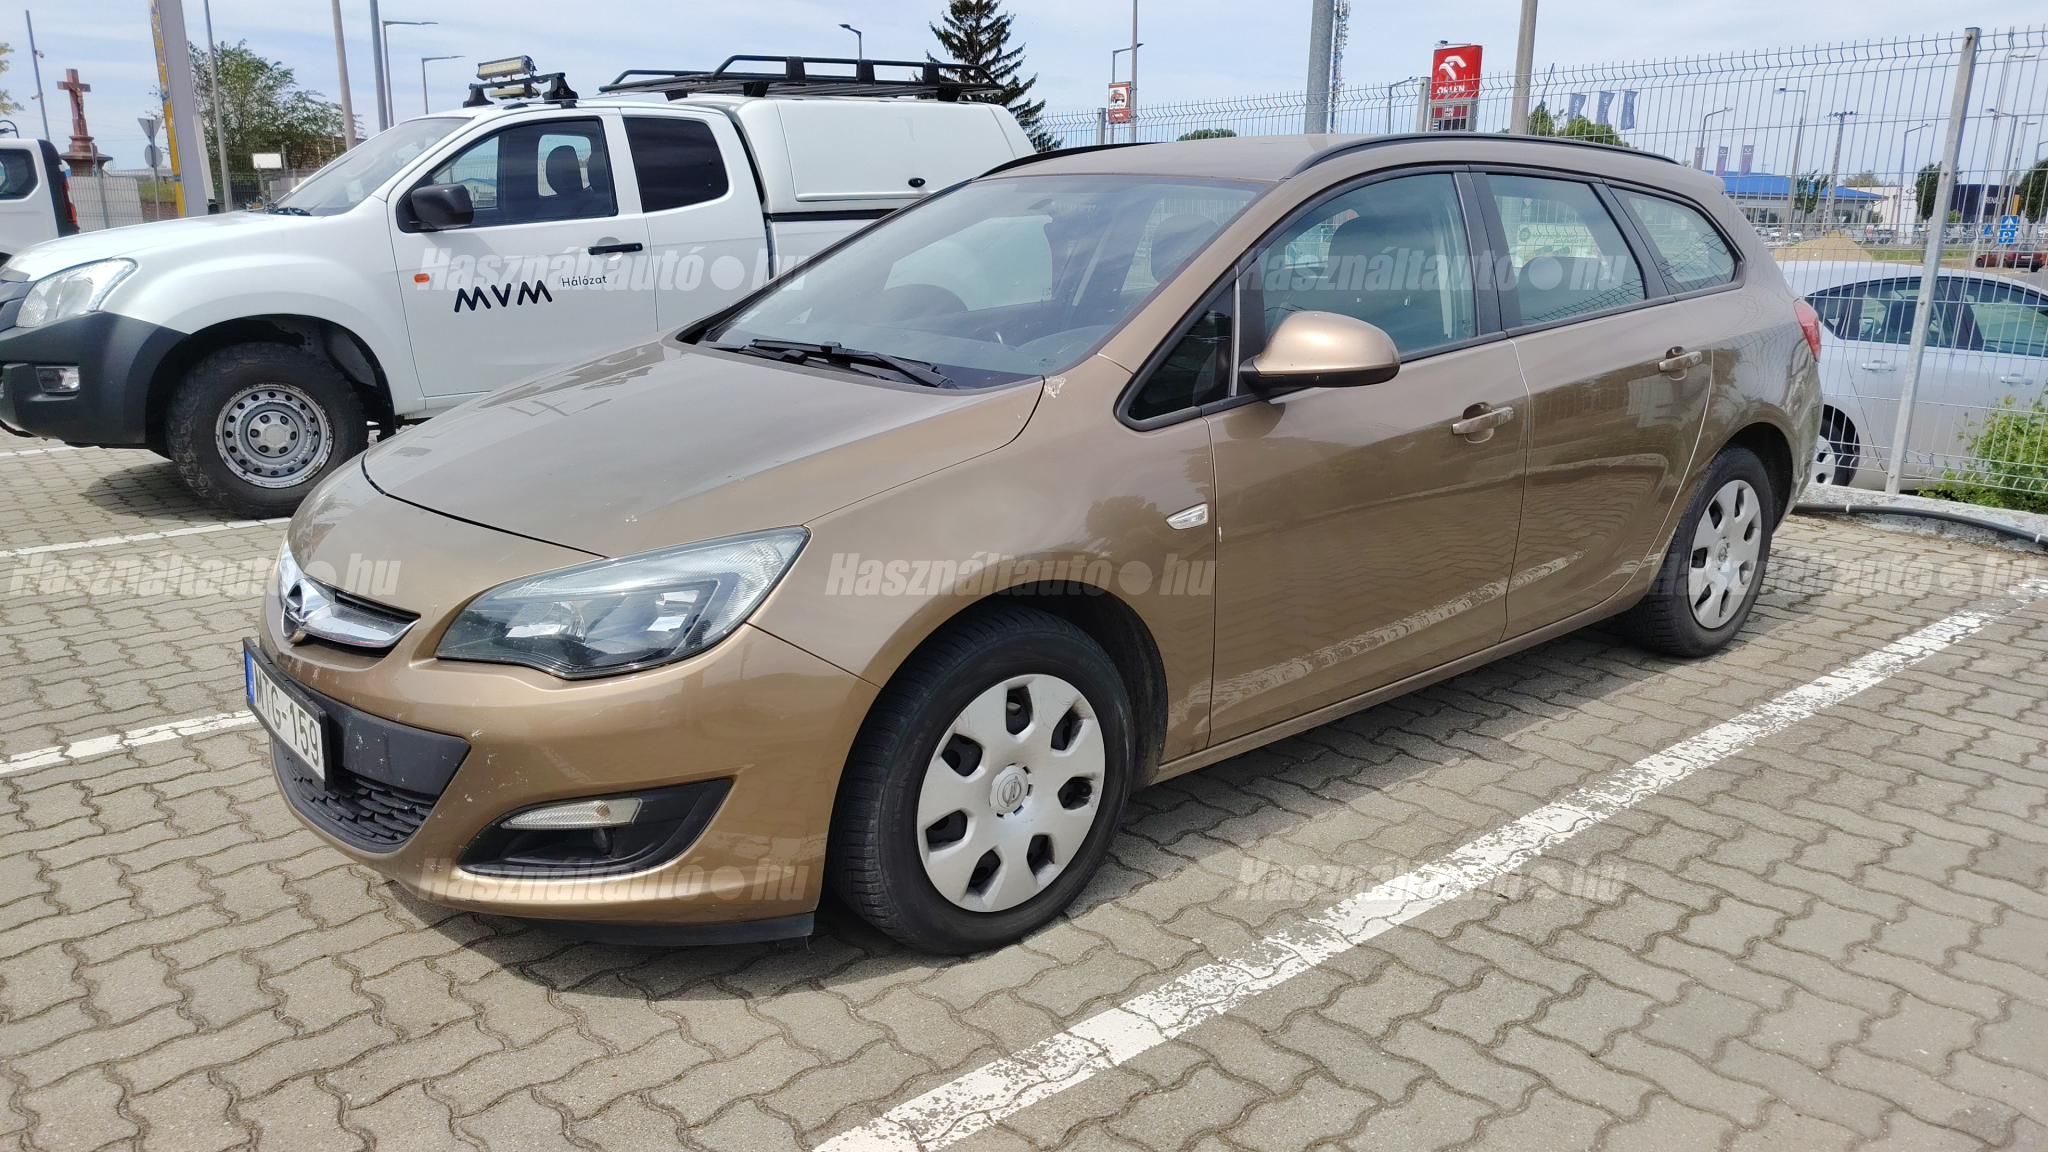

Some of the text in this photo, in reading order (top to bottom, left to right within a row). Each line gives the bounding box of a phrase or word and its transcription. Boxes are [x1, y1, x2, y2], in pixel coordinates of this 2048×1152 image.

[454, 280, 553, 313] MVM
[561, 275, 608, 288] Hálózat
[254, 663, 319, 767] MTG-159
